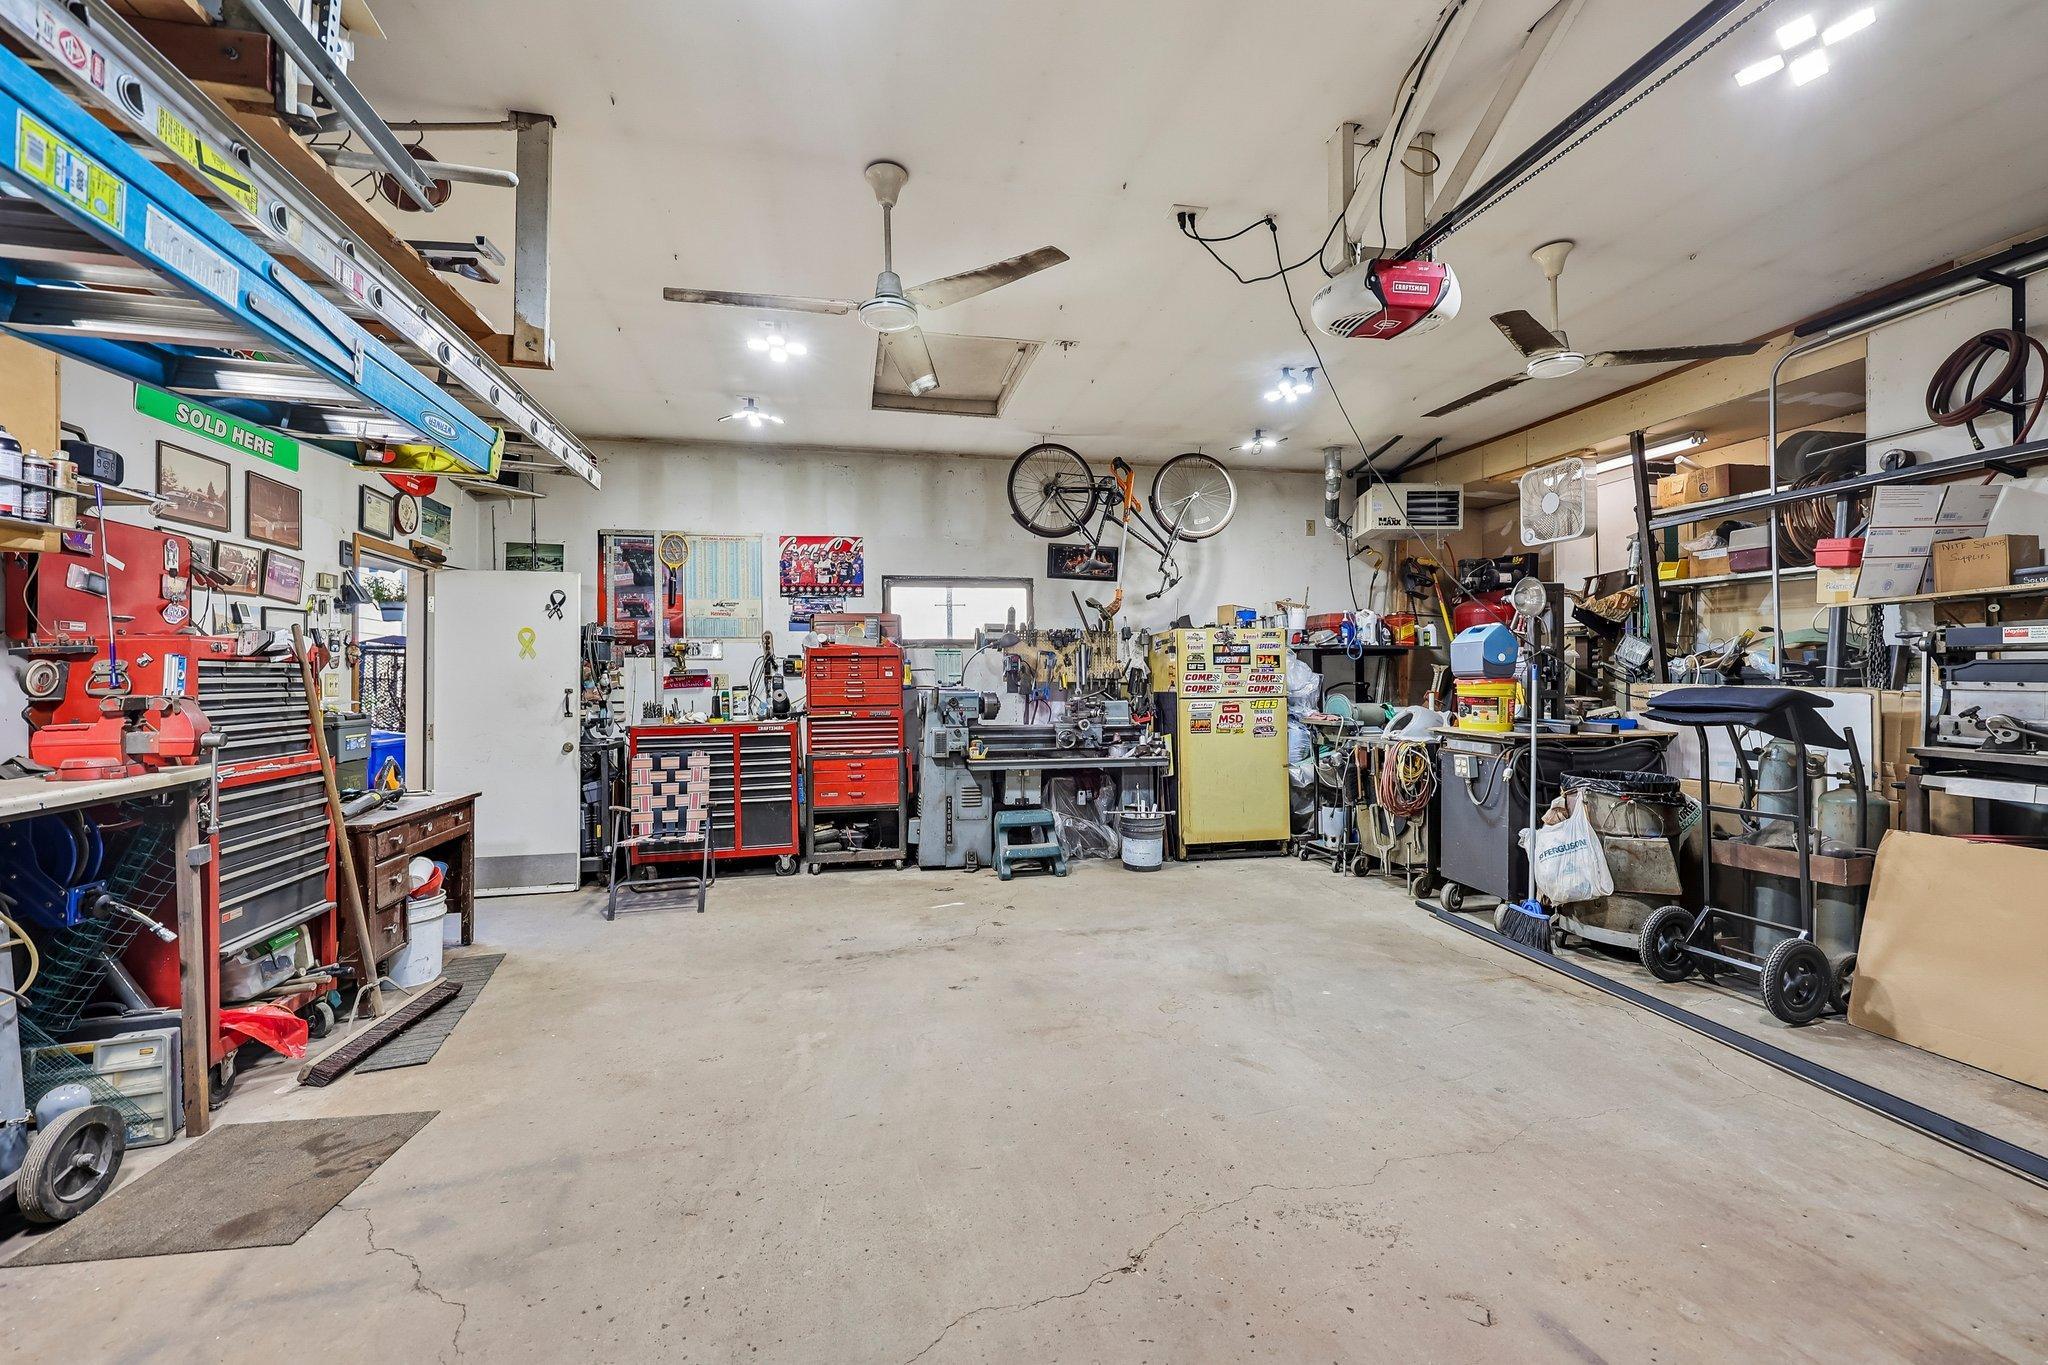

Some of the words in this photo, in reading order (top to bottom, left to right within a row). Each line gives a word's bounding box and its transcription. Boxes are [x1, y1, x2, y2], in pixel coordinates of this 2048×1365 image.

[1395, 283, 1427, 292] CRAFTSMAN
[175, 402, 228, 438] SOLD
[231, 426, 274, 458] HERE
[1255, 700, 1277, 709] JEGS
[1219, 715, 1243, 723] MSD
[1543, 839, 1587, 857] FERGUSON
